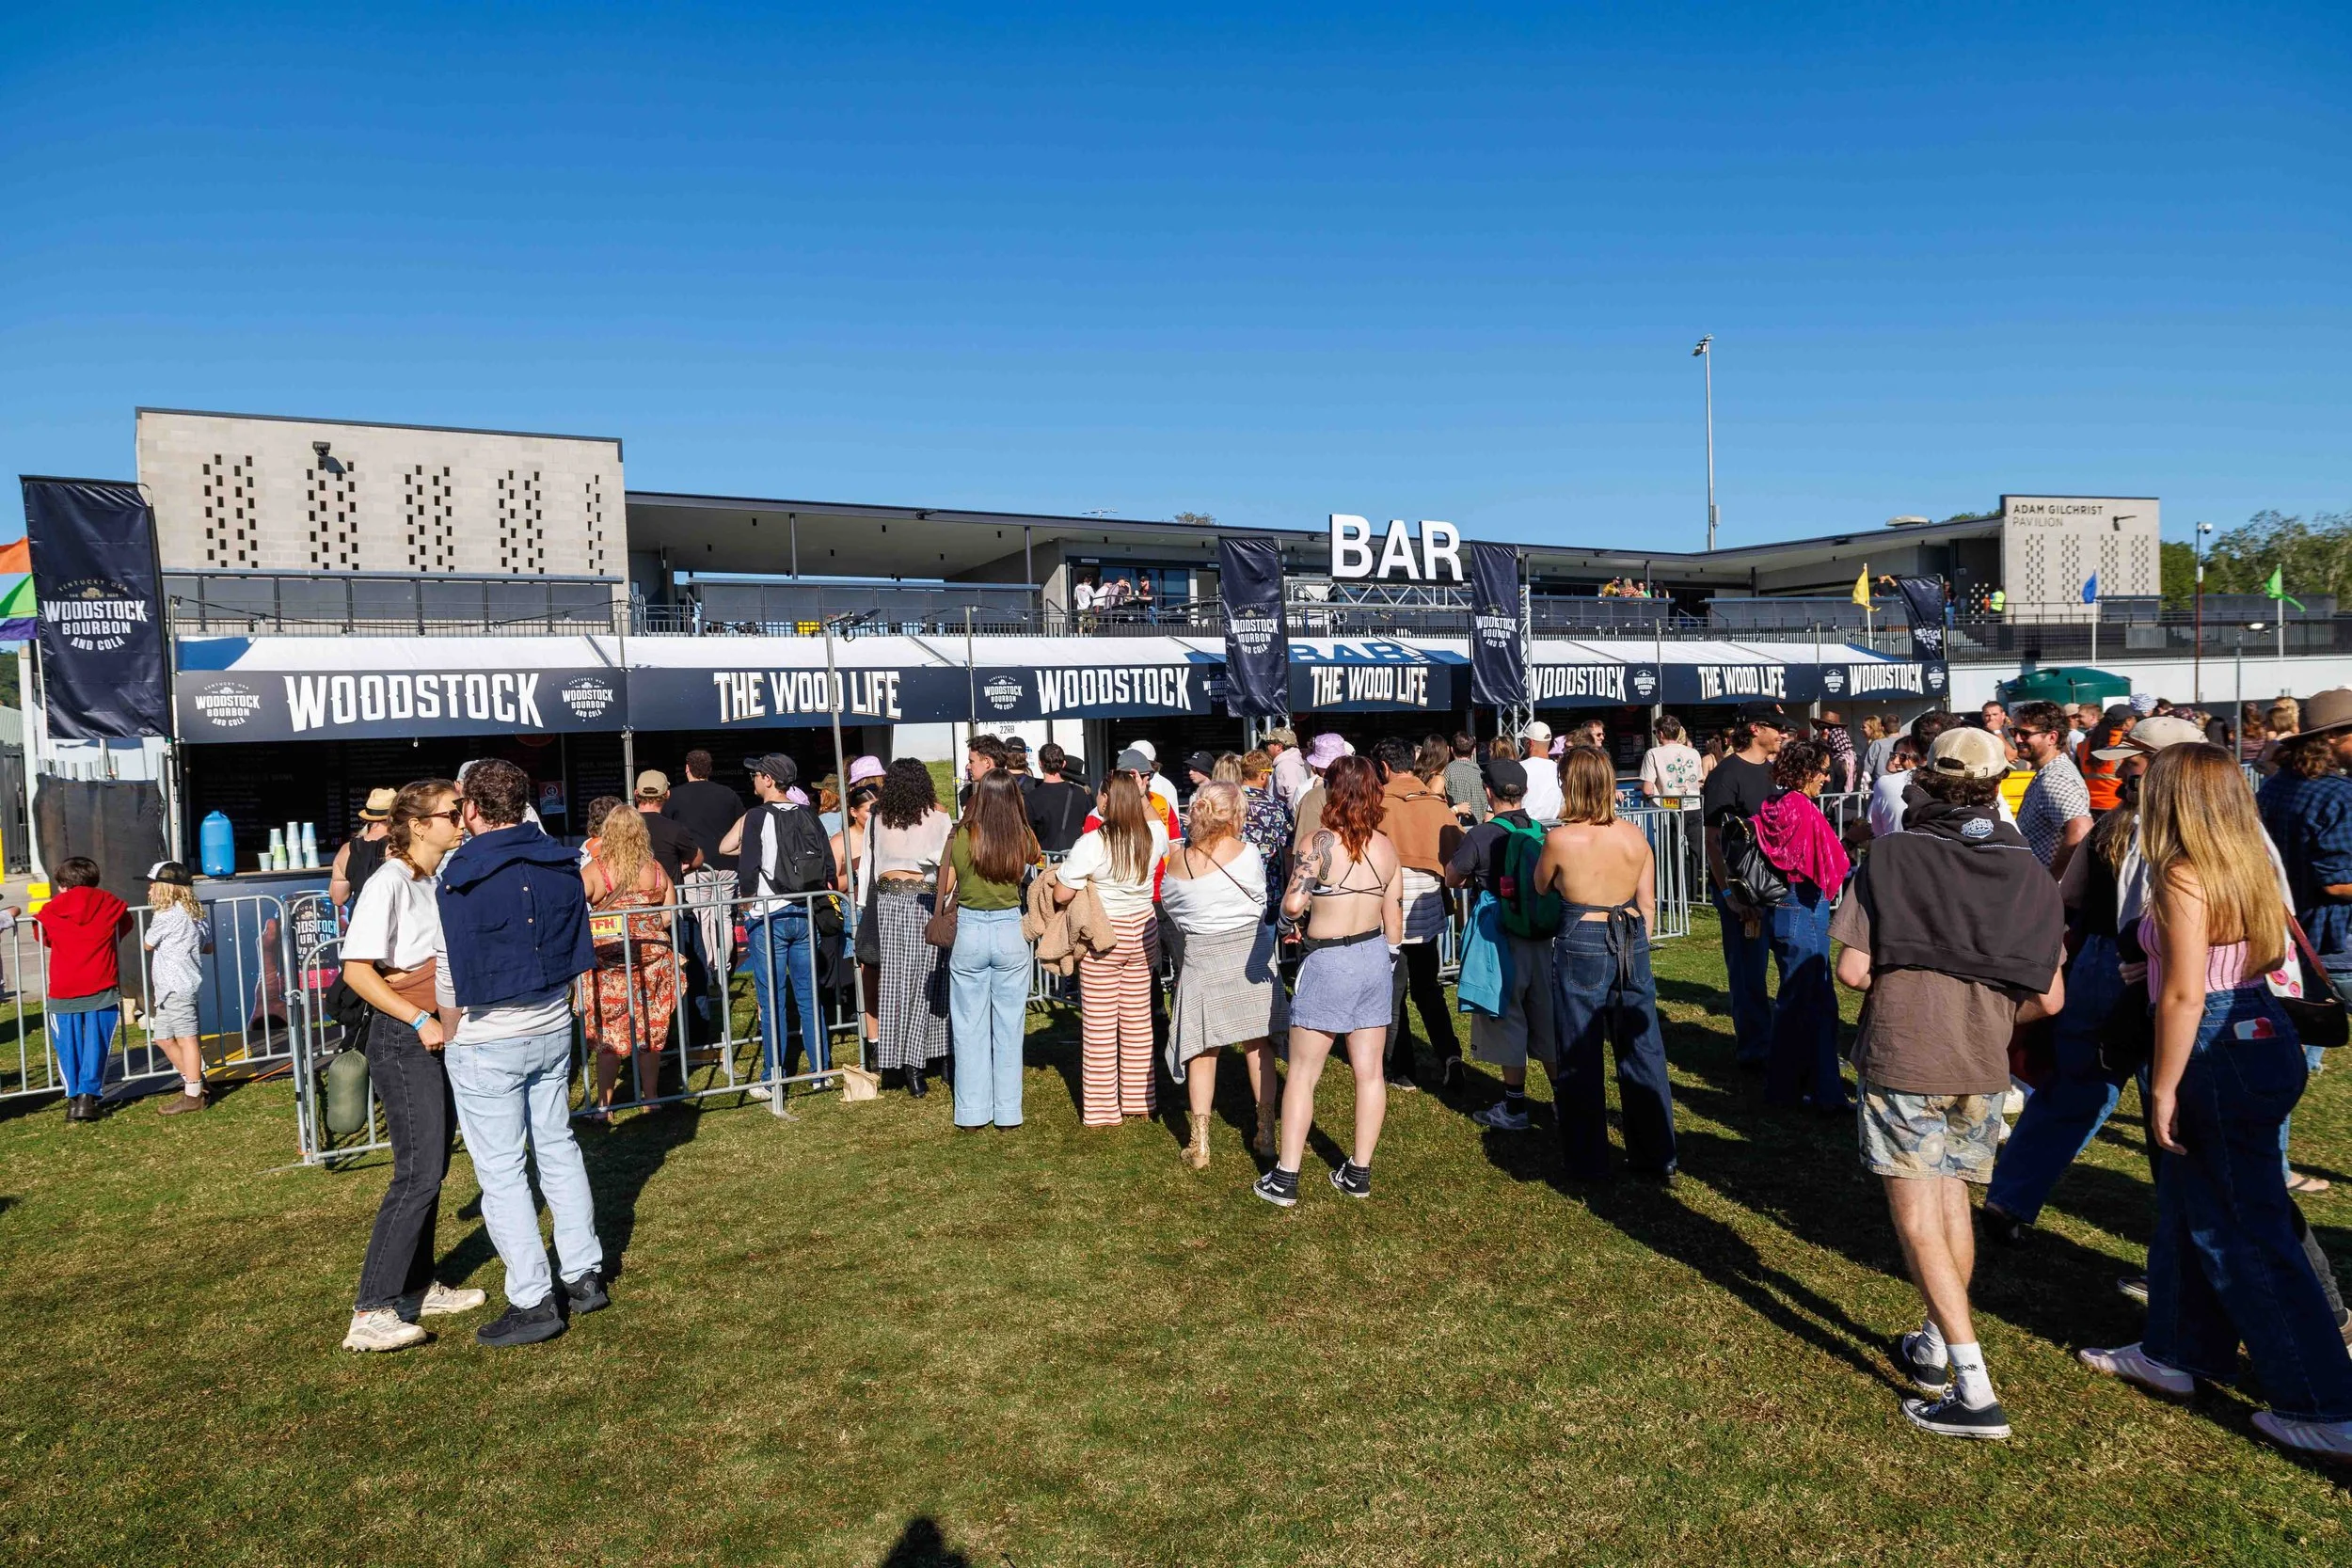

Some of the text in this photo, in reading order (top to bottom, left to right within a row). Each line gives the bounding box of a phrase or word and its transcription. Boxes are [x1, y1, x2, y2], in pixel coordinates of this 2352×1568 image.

[2013, 504, 2103, 515] ADAM GILCHRIST
[2012, 515, 2063, 528] PAVILION
[1329, 514, 1464, 581] BAR
[43, 600, 148, 623] WOODSTOCK
[62, 621, 132, 636] BOURBON
[71, 635, 125, 651] AND COLA
[1311, 666, 1429, 707] THE WOOD LIFE
[1697, 666, 1723, 700] THE
[1723, 666, 1759, 695] WOOD
[1760, 666, 1787, 700] LIFE
[1849, 663, 1924, 697] WOODSTOCK
[562, 689, 613, 703] WOODSTOCK
[713, 672, 766, 723] THE
[850, 671, 902, 721] LIFE
[983, 685, 1023, 697] WOODSTOCK
[1035, 667, 1192, 715] WOODSTOCK
[195, 694, 261, 710] WOODSTOCK
[283, 673, 544, 733] WOODSTOCK
[571, 700, 606, 709] BOURBON
[206, 707, 250, 717] BOURBON
[575, 708, 603, 718] AND COLA
[212, 717, 246, 727] AND COLA
